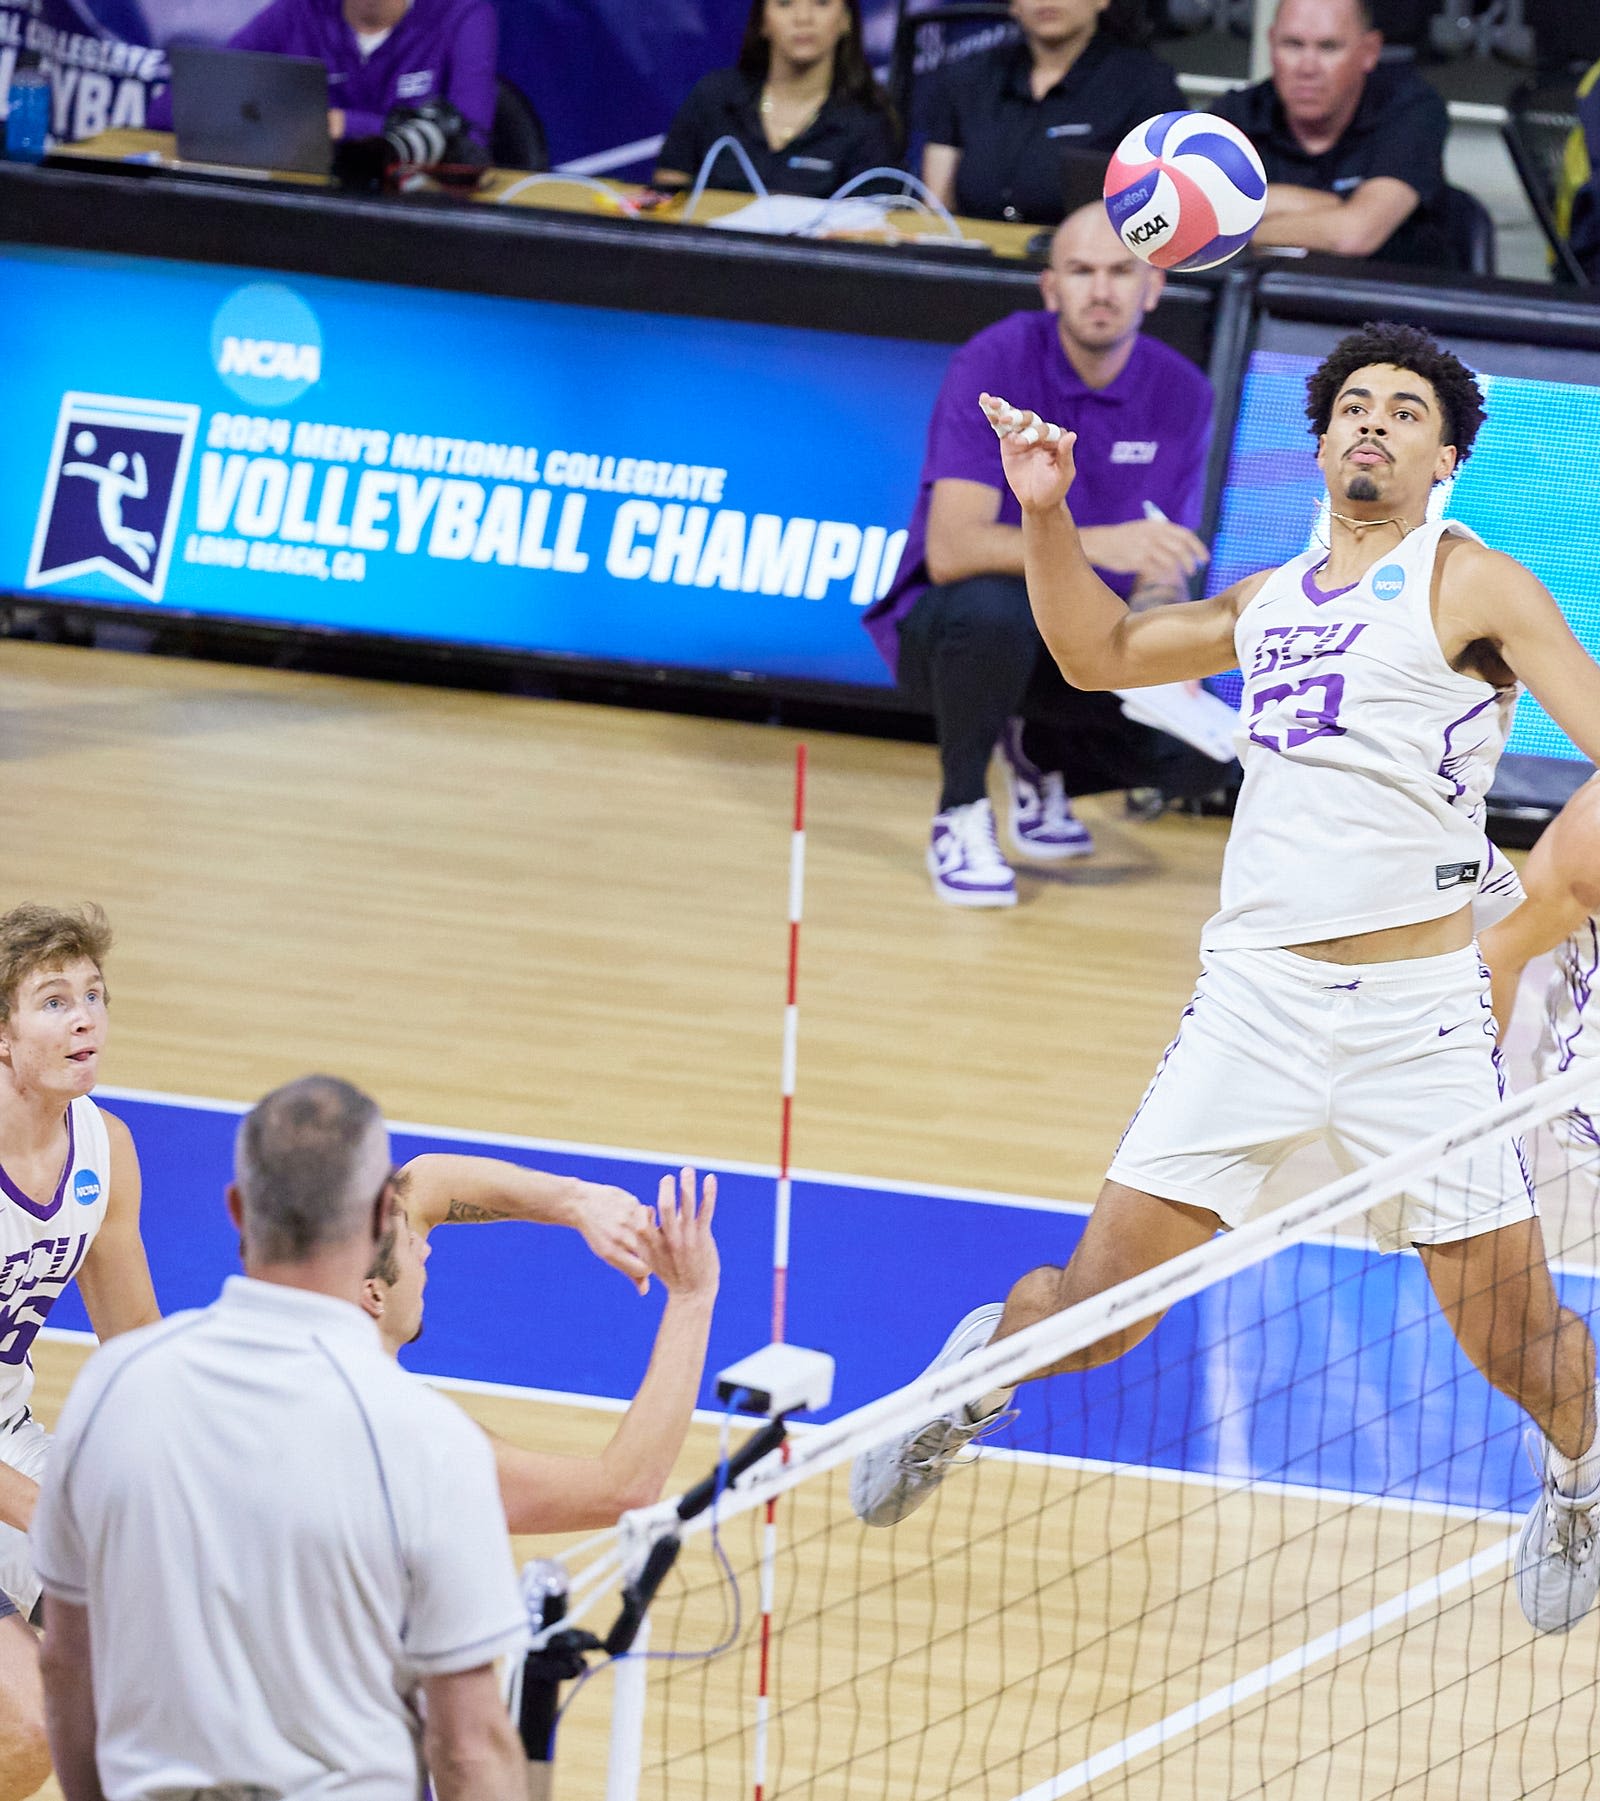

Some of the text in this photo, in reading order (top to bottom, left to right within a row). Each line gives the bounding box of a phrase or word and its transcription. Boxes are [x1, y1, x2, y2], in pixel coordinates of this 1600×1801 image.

[1113, 187, 1149, 216] molten
[1126, 214, 1169, 247] NCAA
[218, 336, 321, 384] NCAA
[206, 412, 728, 504] 2024 MEN'S NATIONAL COLLEGIATE
[196, 452, 589, 574] VOLLEYBALL
[184, 533, 248, 569] LONG
[331, 551, 367, 582] CA
[1374, 580, 1402, 591] NCAA
[1249, 623, 1370, 680] GCU
[1249, 673, 1348, 752] 23
[1463, 868, 1475, 878] XL
[75, 1184, 101, 1198] NCAA
